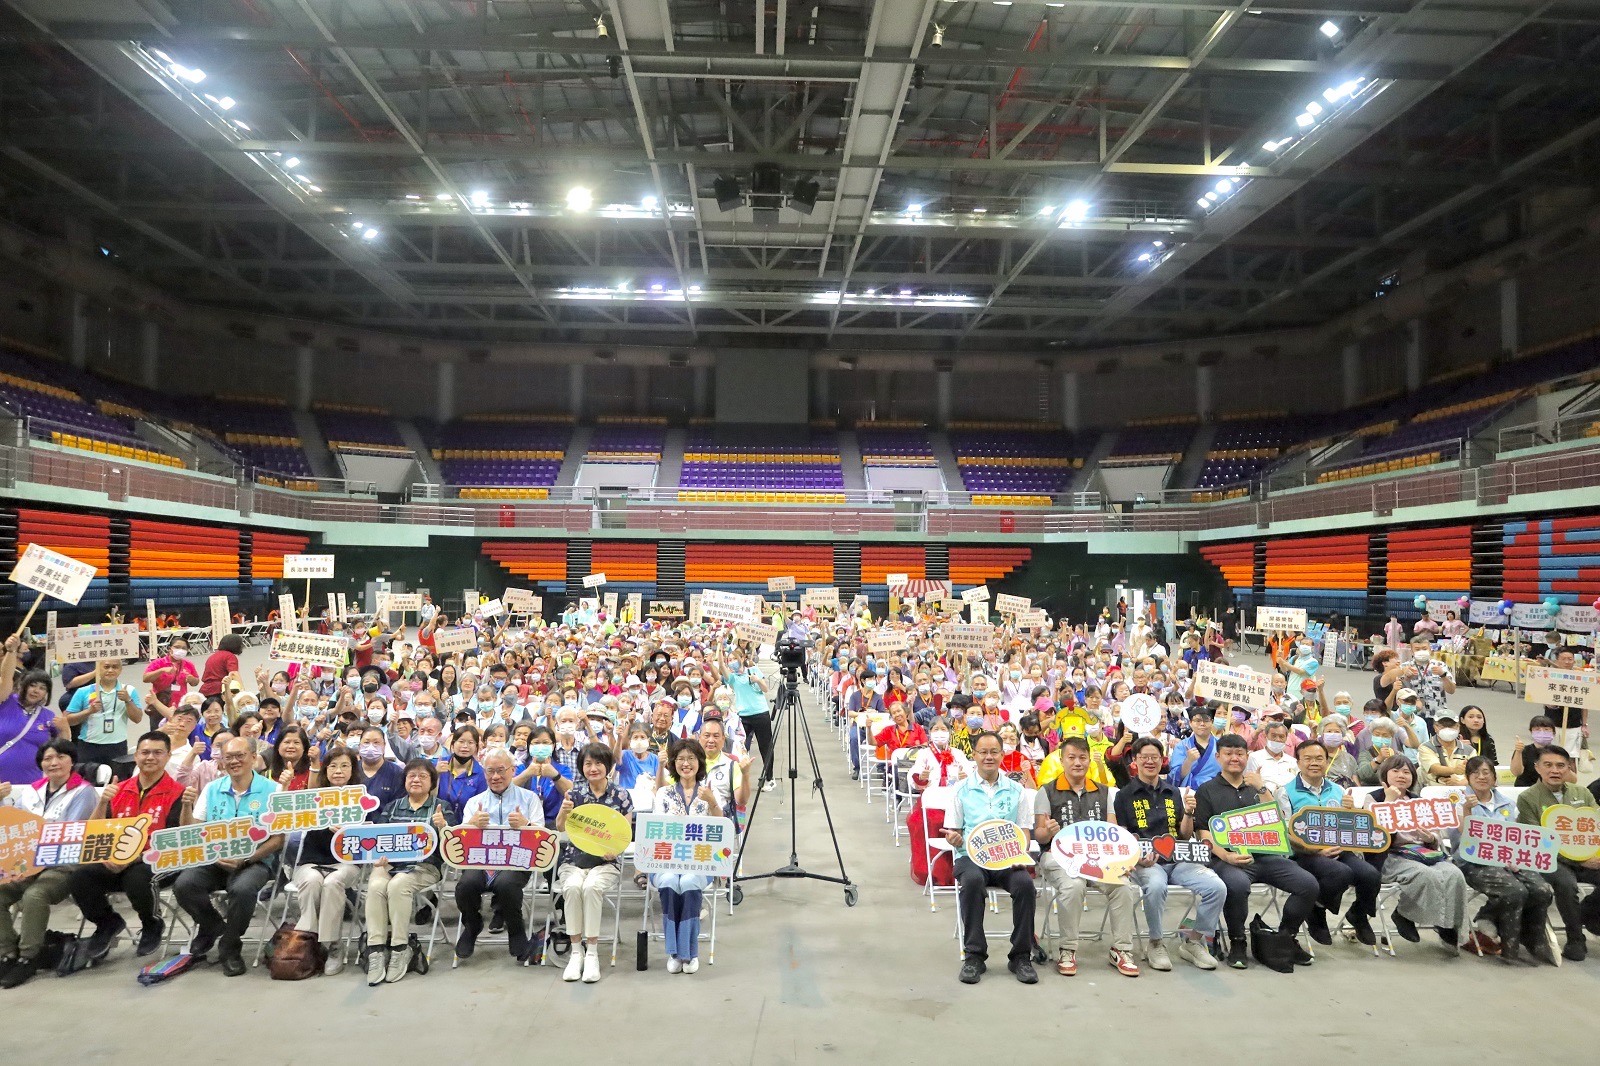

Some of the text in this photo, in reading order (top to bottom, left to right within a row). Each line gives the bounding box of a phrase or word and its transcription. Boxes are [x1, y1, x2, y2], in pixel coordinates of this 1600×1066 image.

[35, 565, 71, 584] 屏東社區
[29, 576, 65, 595] 服務據點
[67, 649, 129, 660] 社區服務據點
[73, 639, 124, 649] 三地門失智
[277, 642, 340, 657] 地磨兒樂智據點
[1201, 675, 1266, 696] 麟洛鄉樂智社區
[1548, 683, 1590, 695] 來家作伴
[1213, 689, 1250, 704] 服務據點
[1552, 694, 1584, 705] 思想起
[270, 788, 361, 811] 長照同行
[271, 810, 364, 831] 屏東共好
[569, 812, 606, 829] 屏東縣政府
[1228, 809, 1279, 830] 我長照
[1307, 812, 1370, 829] 你我一起
[1374, 799, 1456, 831] 屏東樂智
[40, 822, 86, 844] 屏東
[155, 820, 249, 849] 長照同行
[481, 829, 522, 846] 屏東
[644, 821, 724, 842] 屏東樂智
[970, 823, 1018, 849] 我長照
[1074, 826, 1120, 842] 1966
[1308, 829, 1370, 846] 守護長照
[1468, 819, 1542, 849] 長照同行
[35, 844, 82, 866] 長照
[82, 833, 115, 862] 讚
[156, 838, 253, 868] 屏東共好
[342, 834, 413, 855] 我 長照
[654, 842, 713, 862] 嘉年華
[976, 841, 1022, 865] 我驕傲
[1072, 843, 1130, 856] 長照專線
[1174, 841, 1210, 862] 長照
[467, 846, 532, 869] 長照讚
[1478, 842, 1552, 871] 屏東共好
